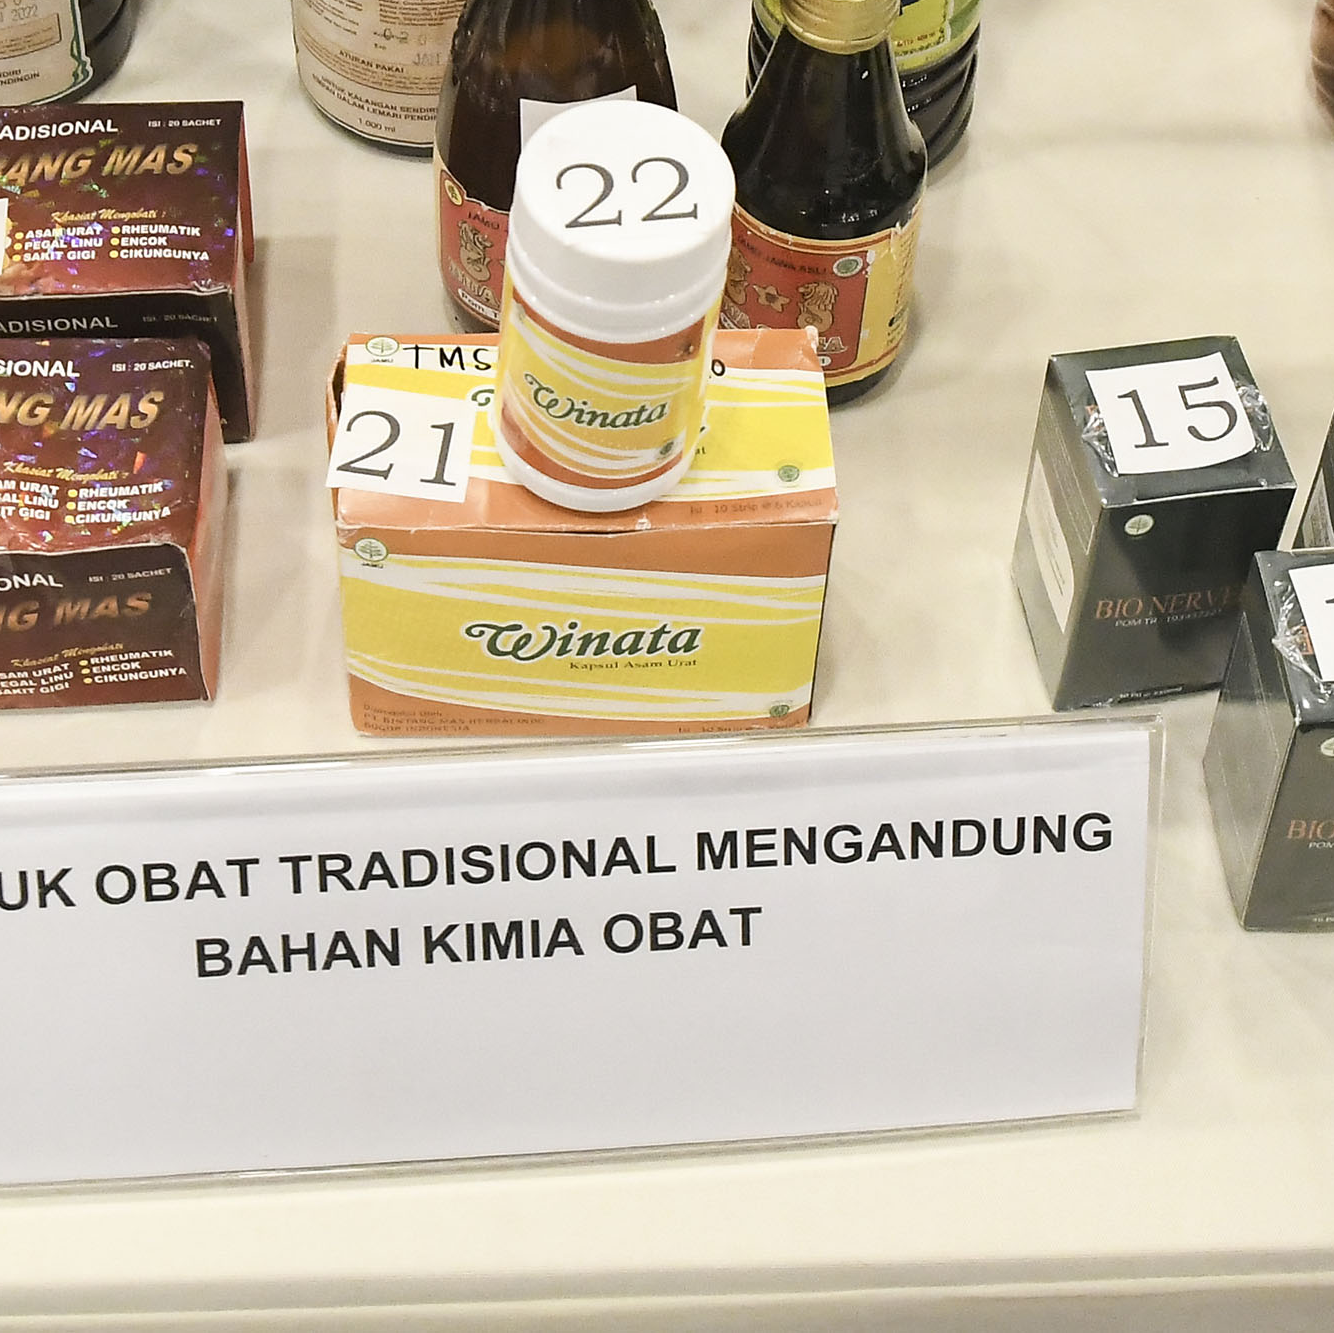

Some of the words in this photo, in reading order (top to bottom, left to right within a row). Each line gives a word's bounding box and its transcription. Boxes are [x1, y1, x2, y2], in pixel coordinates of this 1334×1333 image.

[101, 143, 198, 177] MAS
[555, 156, 699, 230] 22
[25, 238, 68, 250] PEGAL
[72, 236, 104, 248] LINU
[121, 224, 201, 237] RHEUMATIK
[121, 236, 167, 246] ENCOK
[120, 248, 209, 261] CIKUNGUNYA
[60, 390, 165, 432] MAS
[525, 373, 671, 433] Winata
[1116, 376, 1238, 449] 15
[336, 410, 458, 487] 21
[53, 591, 153, 623] MAS
[464, 620, 703, 662] Winata
[569, 659, 620, 672] Kapsul
[624, 659, 664, 670] Asam
[667, 658, 698, 670] Urat
[95, 858, 260, 905] OBAT
[278, 835, 677, 894] TRADISIONAL
[697, 812, 1113, 871] MENGANDUNG
[196, 927, 400, 978] BAHAN
[423, 918, 585, 965] KIMIA
[603, 906, 762, 954] OBAT
